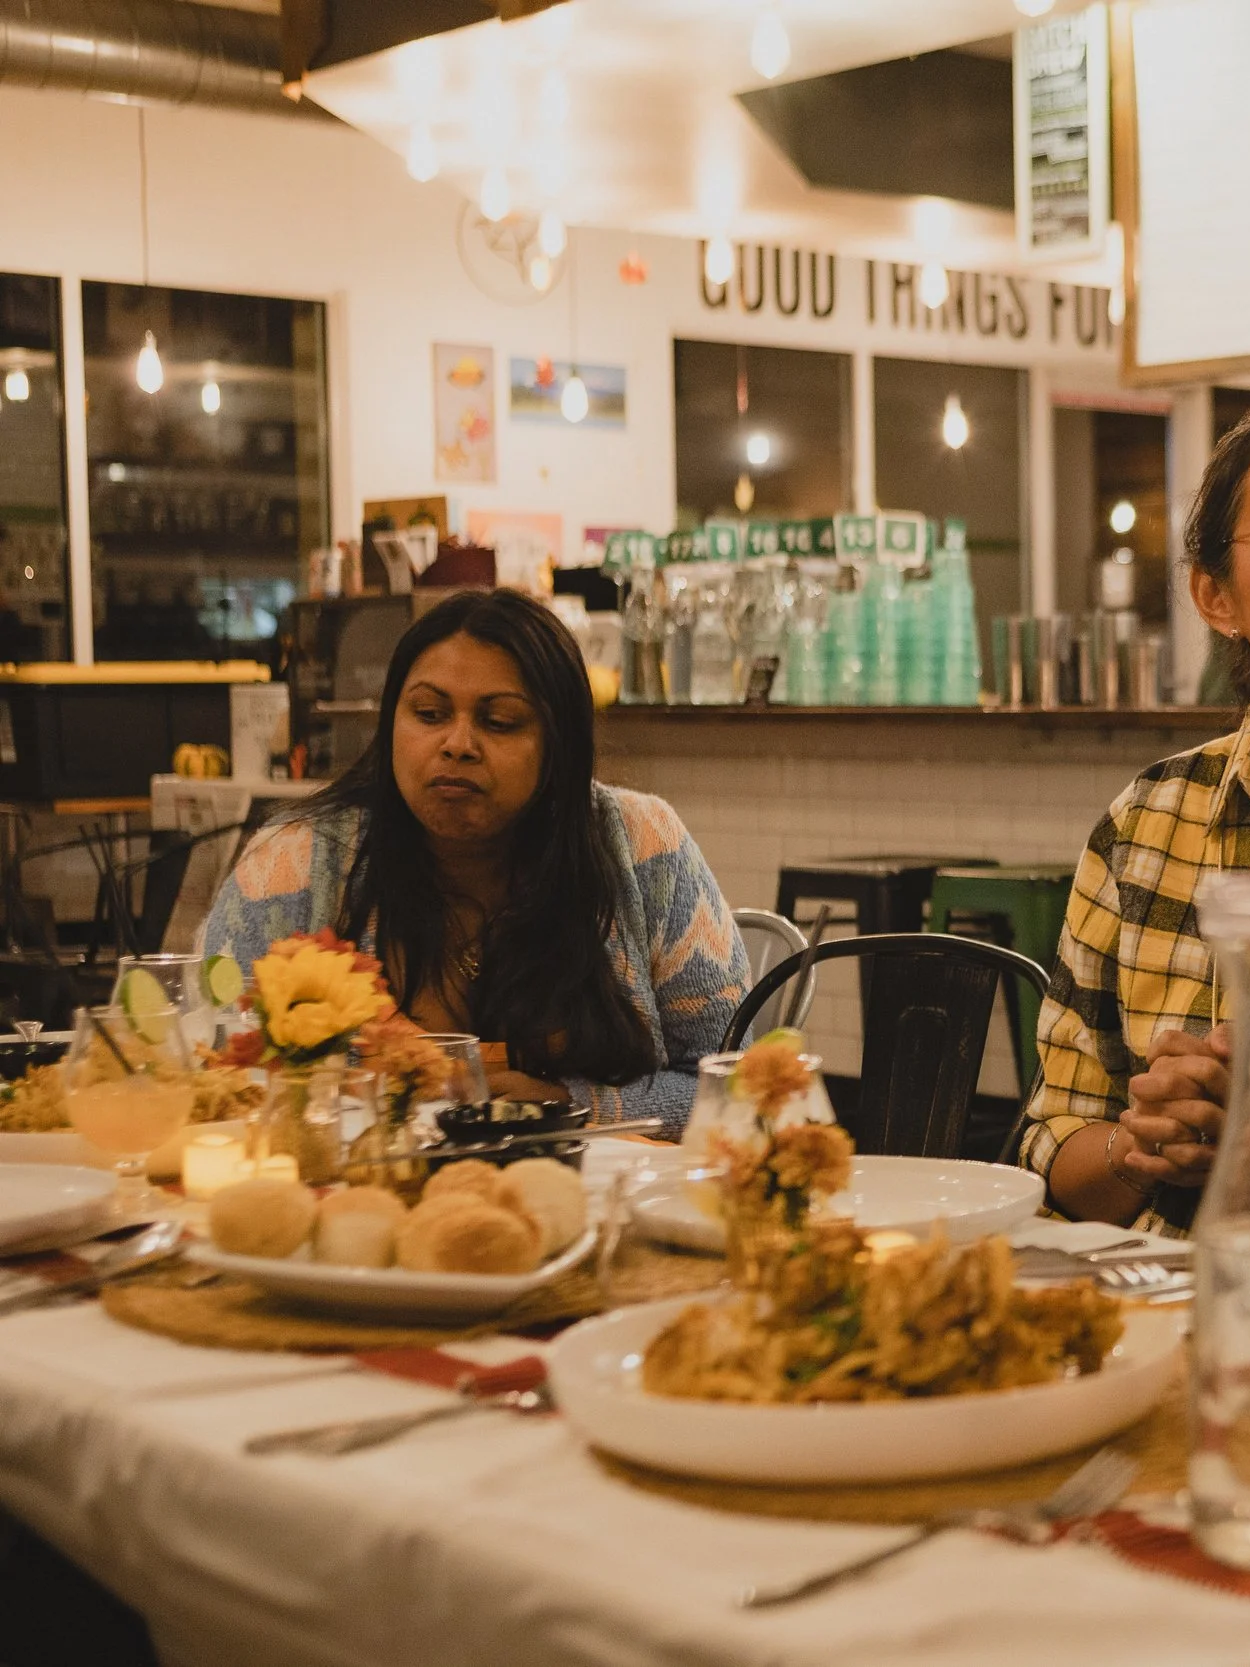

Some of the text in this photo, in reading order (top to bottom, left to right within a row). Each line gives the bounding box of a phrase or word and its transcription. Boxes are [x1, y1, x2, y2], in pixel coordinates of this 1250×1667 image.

[698, 240, 1113, 349] GOOD THNGS FO
